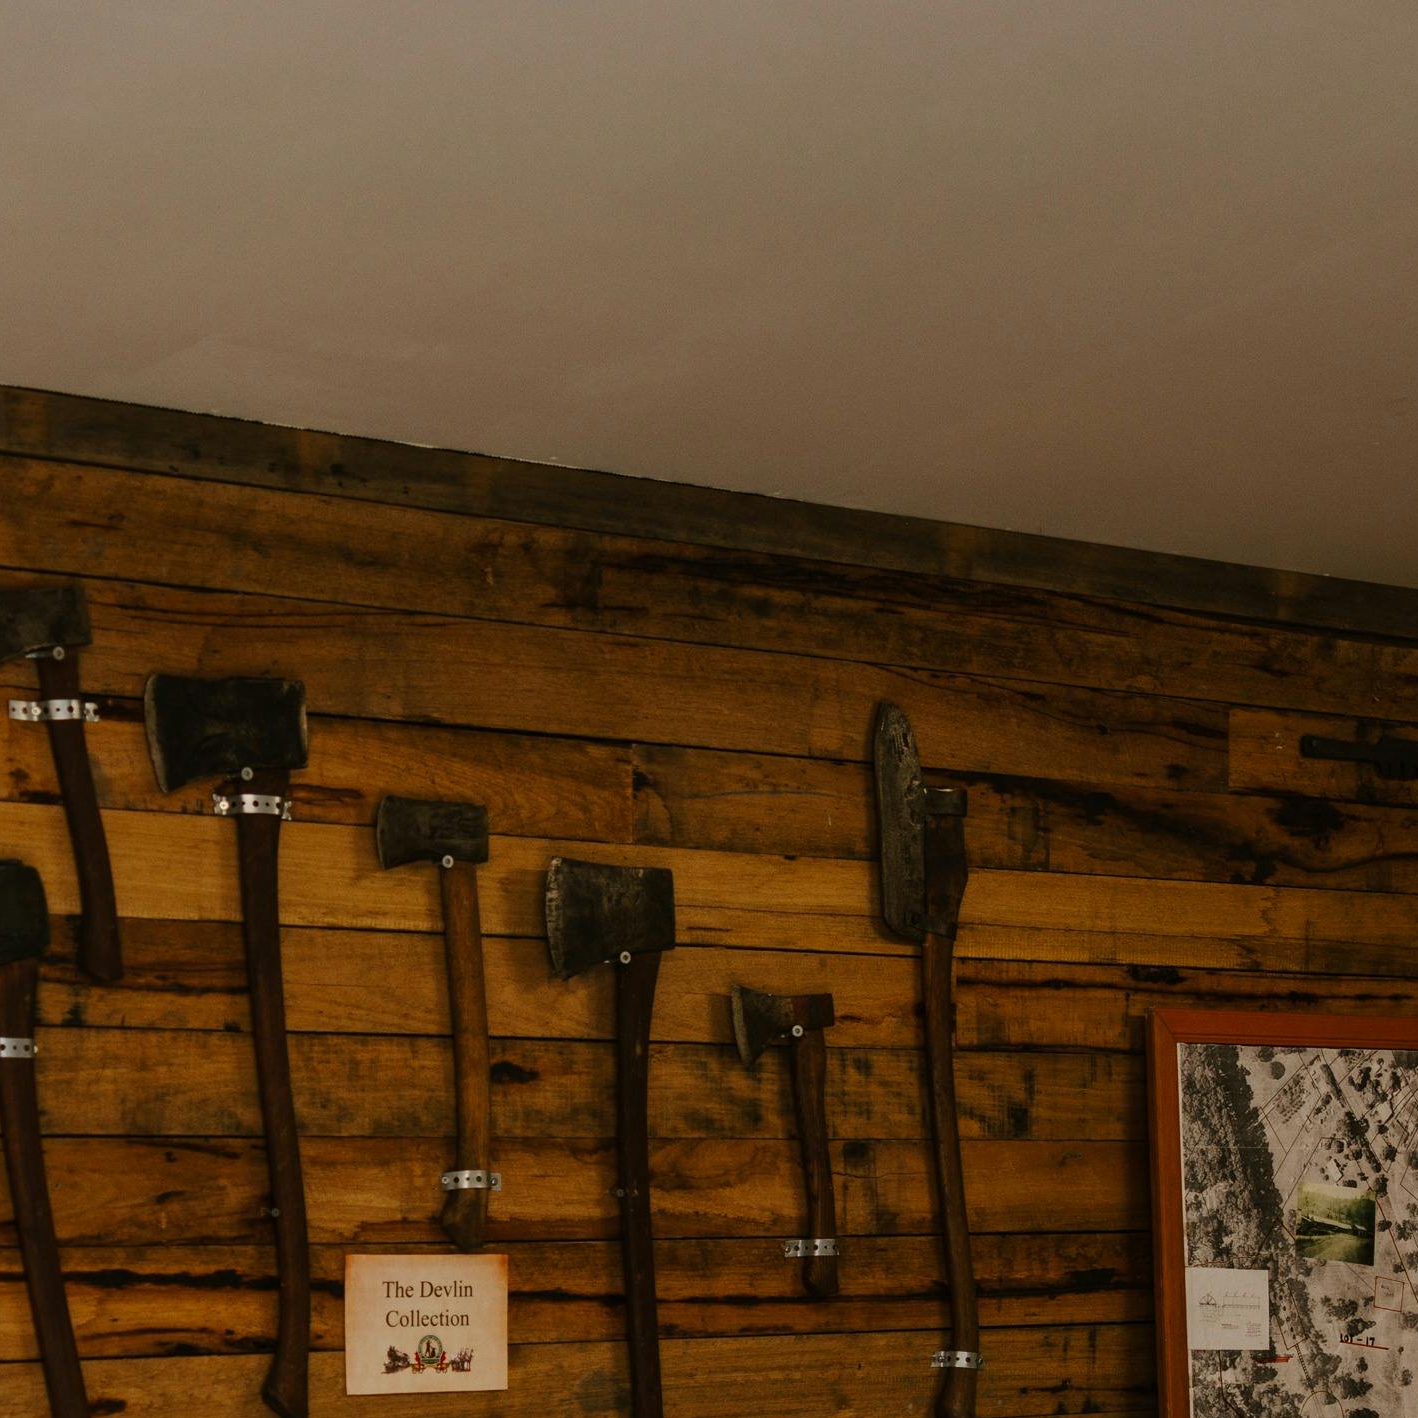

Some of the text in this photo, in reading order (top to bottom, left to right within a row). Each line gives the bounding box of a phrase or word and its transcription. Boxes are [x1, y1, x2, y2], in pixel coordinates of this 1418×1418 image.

[383, 1280, 474, 1298] The Devlin
[386, 1309, 470, 1327] Collection
